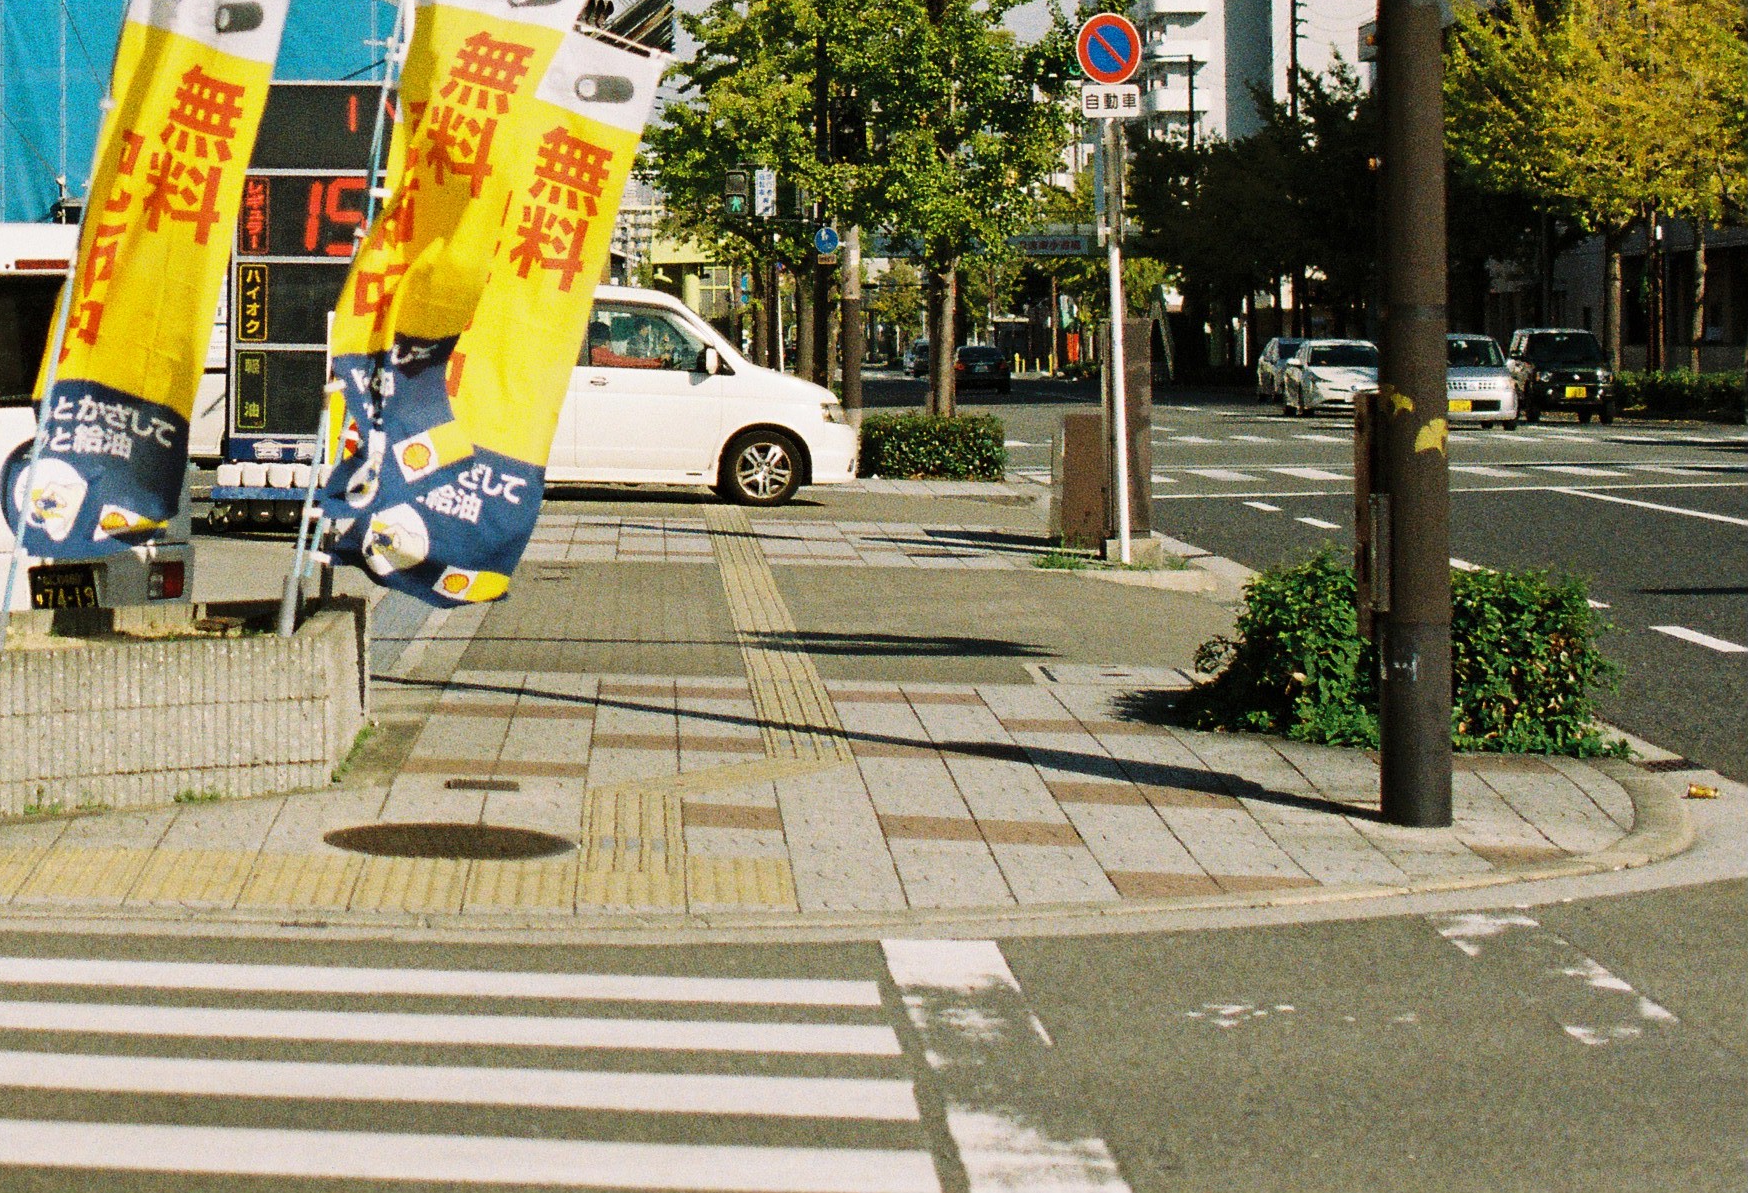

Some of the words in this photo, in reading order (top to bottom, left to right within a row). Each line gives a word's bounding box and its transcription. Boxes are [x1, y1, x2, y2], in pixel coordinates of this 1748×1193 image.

[142, 64, 246, 246] 無料
[424, 30, 537, 199] 無料
[1085, 93, 1136, 109] 自動車
[509, 126, 614, 293] 無料
[245, 269, 261, 334] ハイオク
[53, 394, 177, 448] とかざして
